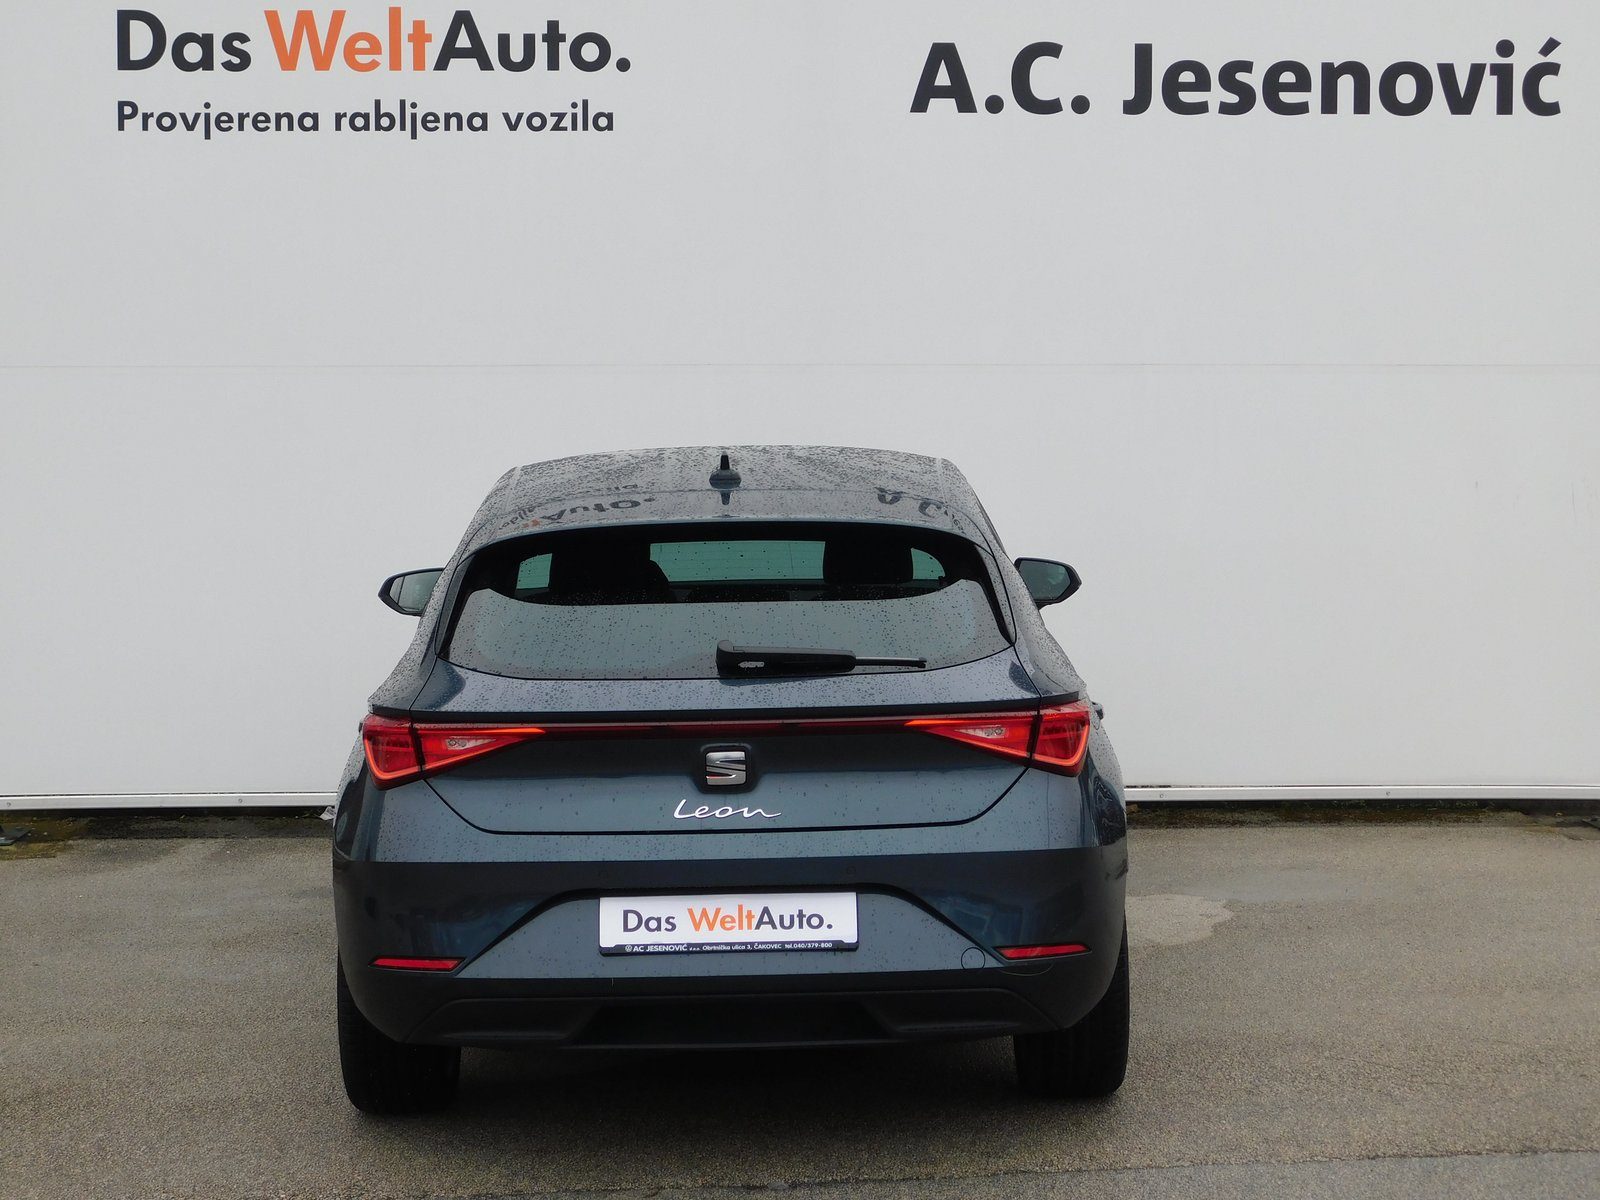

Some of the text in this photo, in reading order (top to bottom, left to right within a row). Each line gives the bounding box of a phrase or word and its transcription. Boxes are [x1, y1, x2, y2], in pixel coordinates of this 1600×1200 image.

[116, 6, 632, 72] Das WeltAuto.
[909, 36, 1563, 117] A.C. Jesenović
[117, 98, 615, 140] Provjerena rabljena vozila
[673, 799, 782, 819] Leon
[622, 904, 833, 933] Das WeltAuto.
[646, 944, 688, 952] JESENOVIĆ
